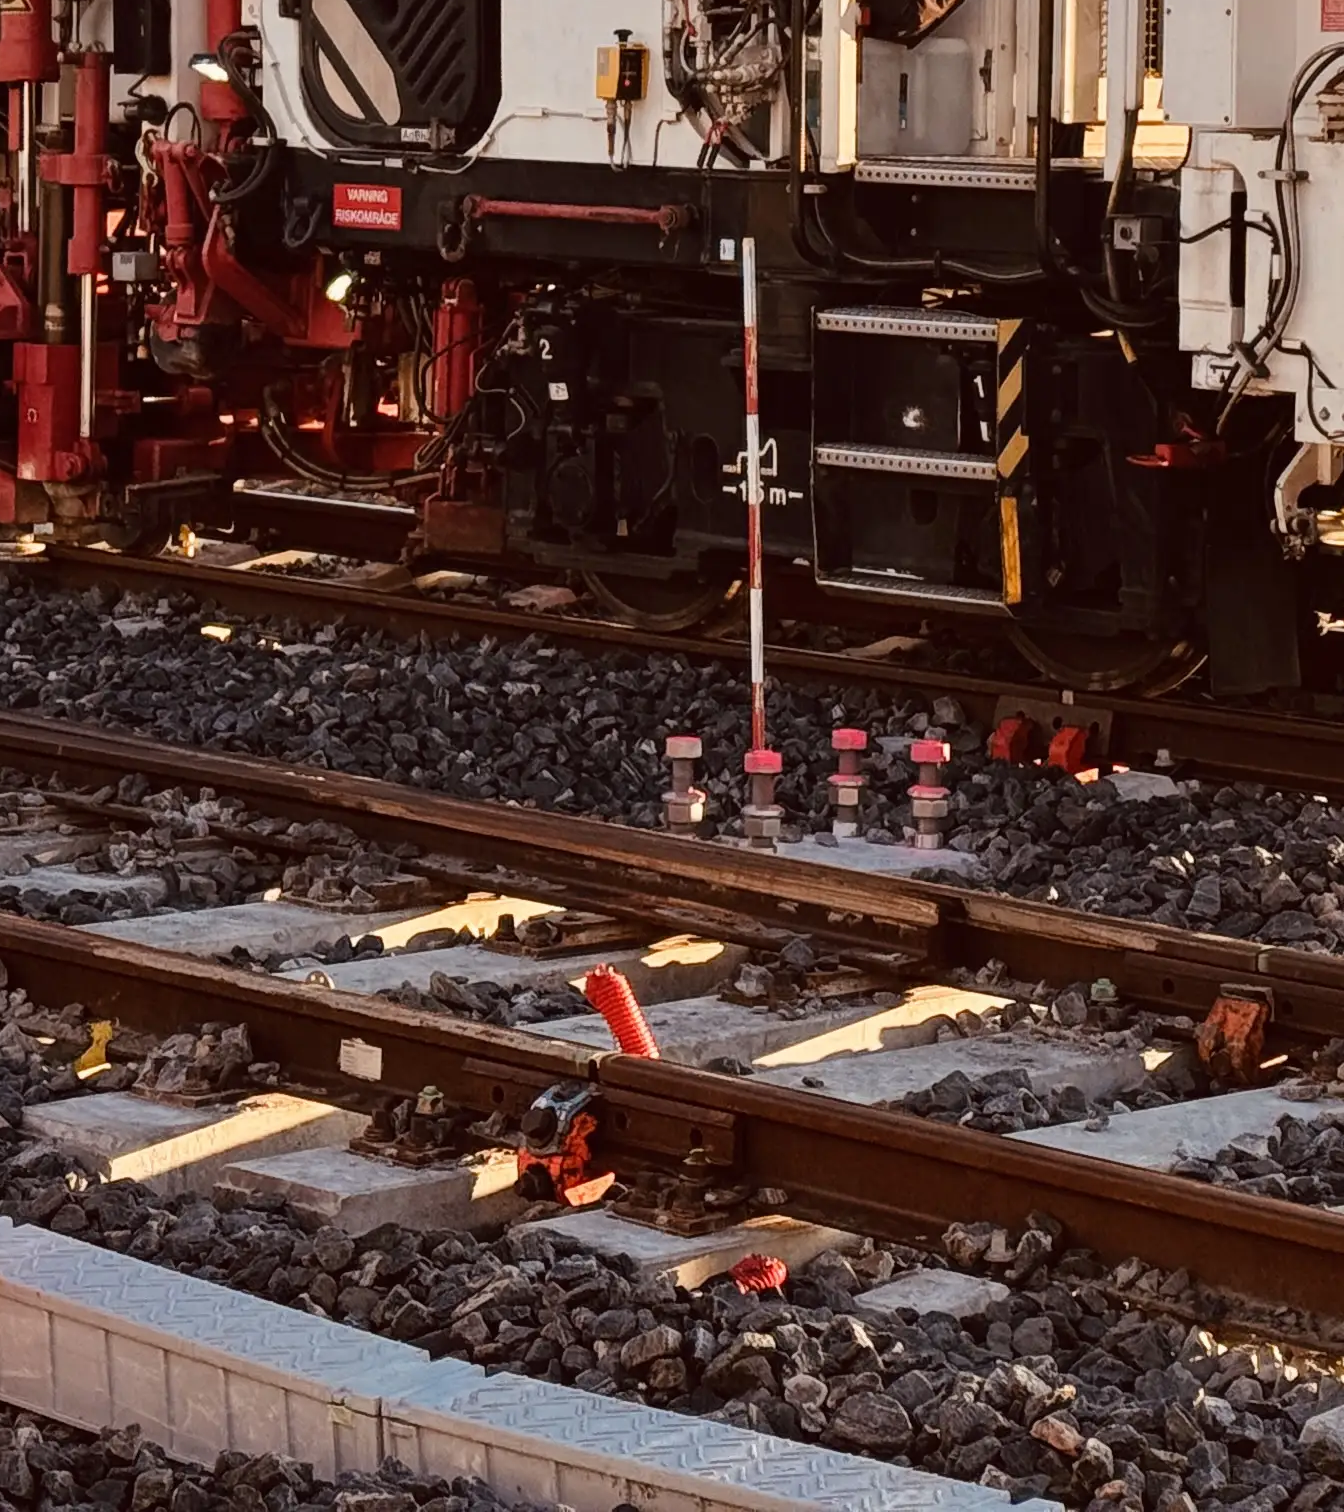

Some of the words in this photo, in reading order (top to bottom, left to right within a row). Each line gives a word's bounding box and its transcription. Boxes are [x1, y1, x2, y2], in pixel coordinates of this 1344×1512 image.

[346, 188, 389, 203] VARNING
[539, 338, 553, 360] 2
[973, 375, 985, 398] 1
